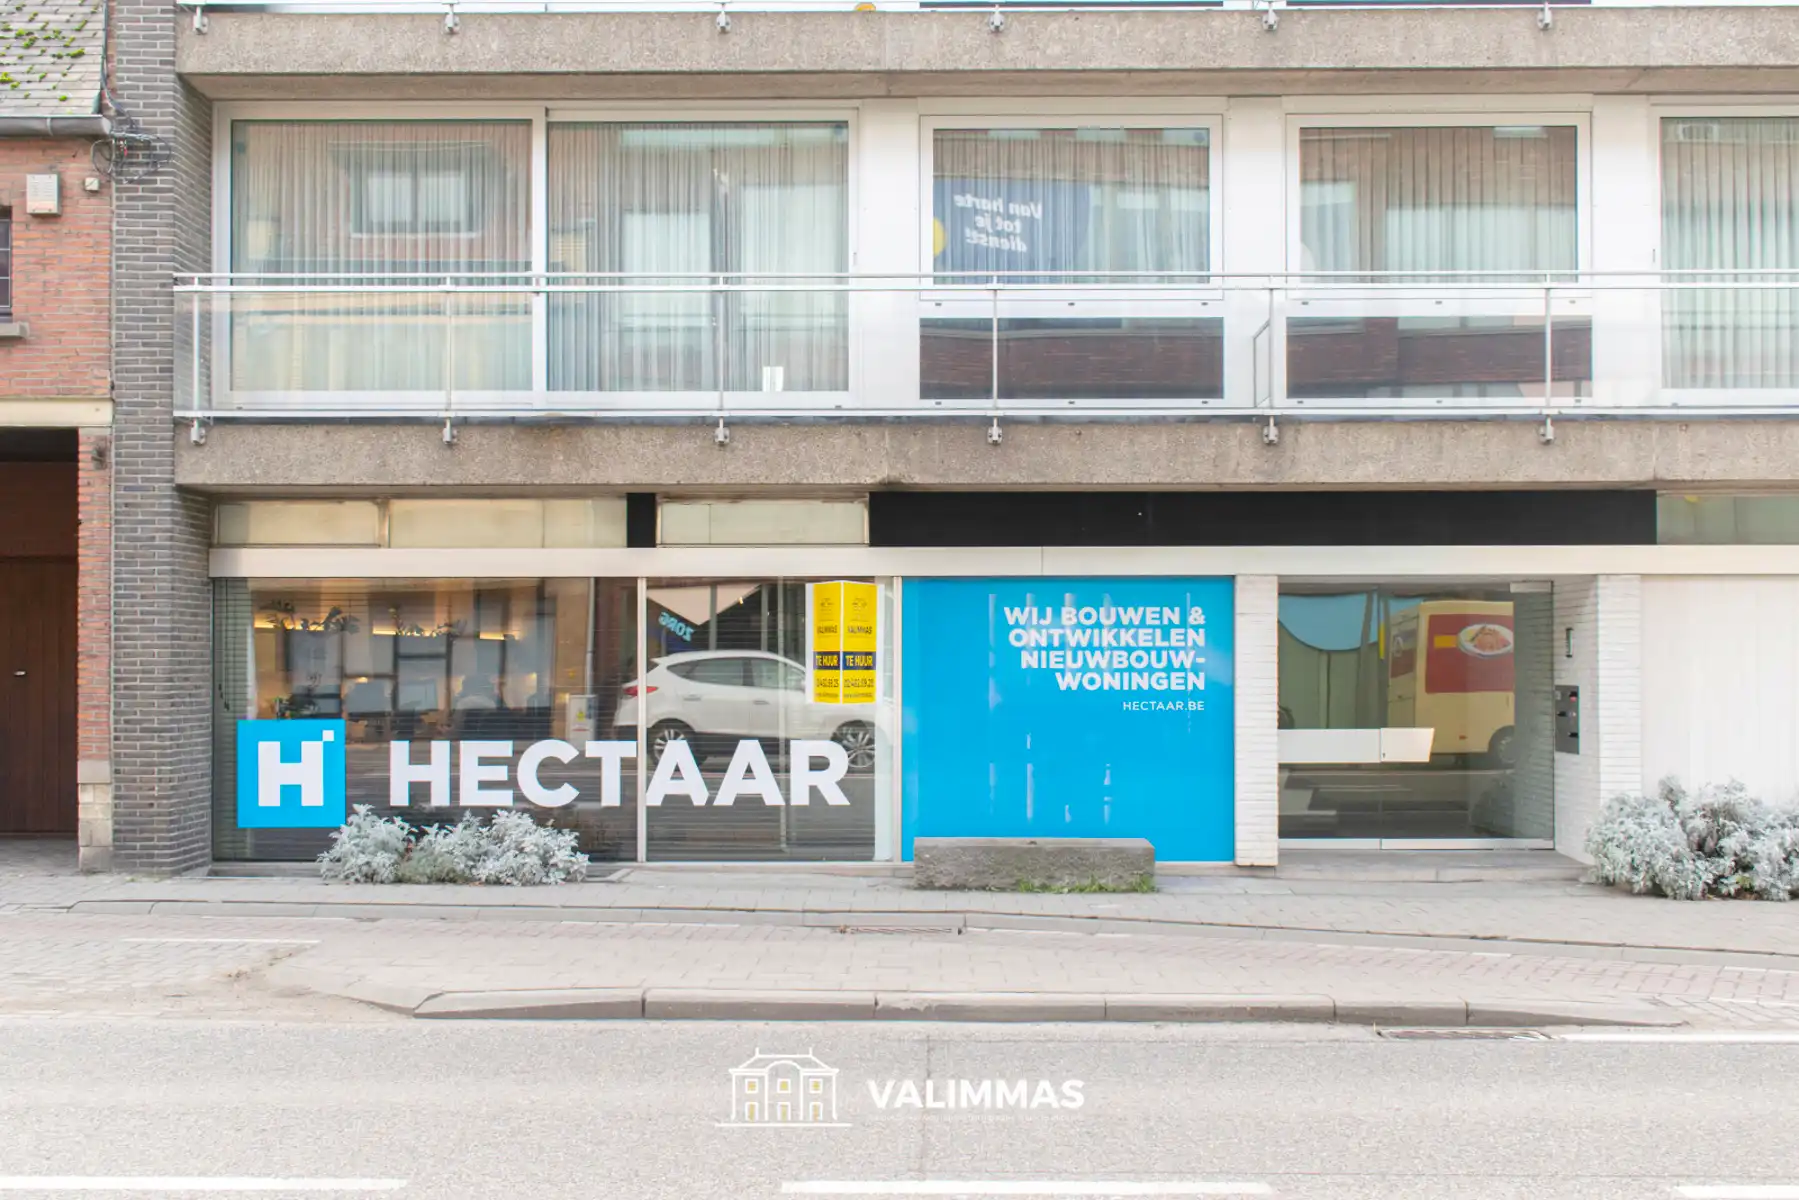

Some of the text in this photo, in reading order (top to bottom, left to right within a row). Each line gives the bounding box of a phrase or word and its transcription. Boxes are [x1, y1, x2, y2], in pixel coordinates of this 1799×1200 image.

[1003, 606, 1206, 626] WIJ BOUWEN &
[1008, 628, 1206, 648] ONTWIKKELEN
[845, 655, 873, 667] TE HUUR
[1020, 650, 1206, 669] NIEUWBOUW-
[1055, 671, 1206, 691] WONINGEN
[1122, 701, 1205, 711] HECTAAR.BE
[390, 739, 850, 808] HECTAAR
